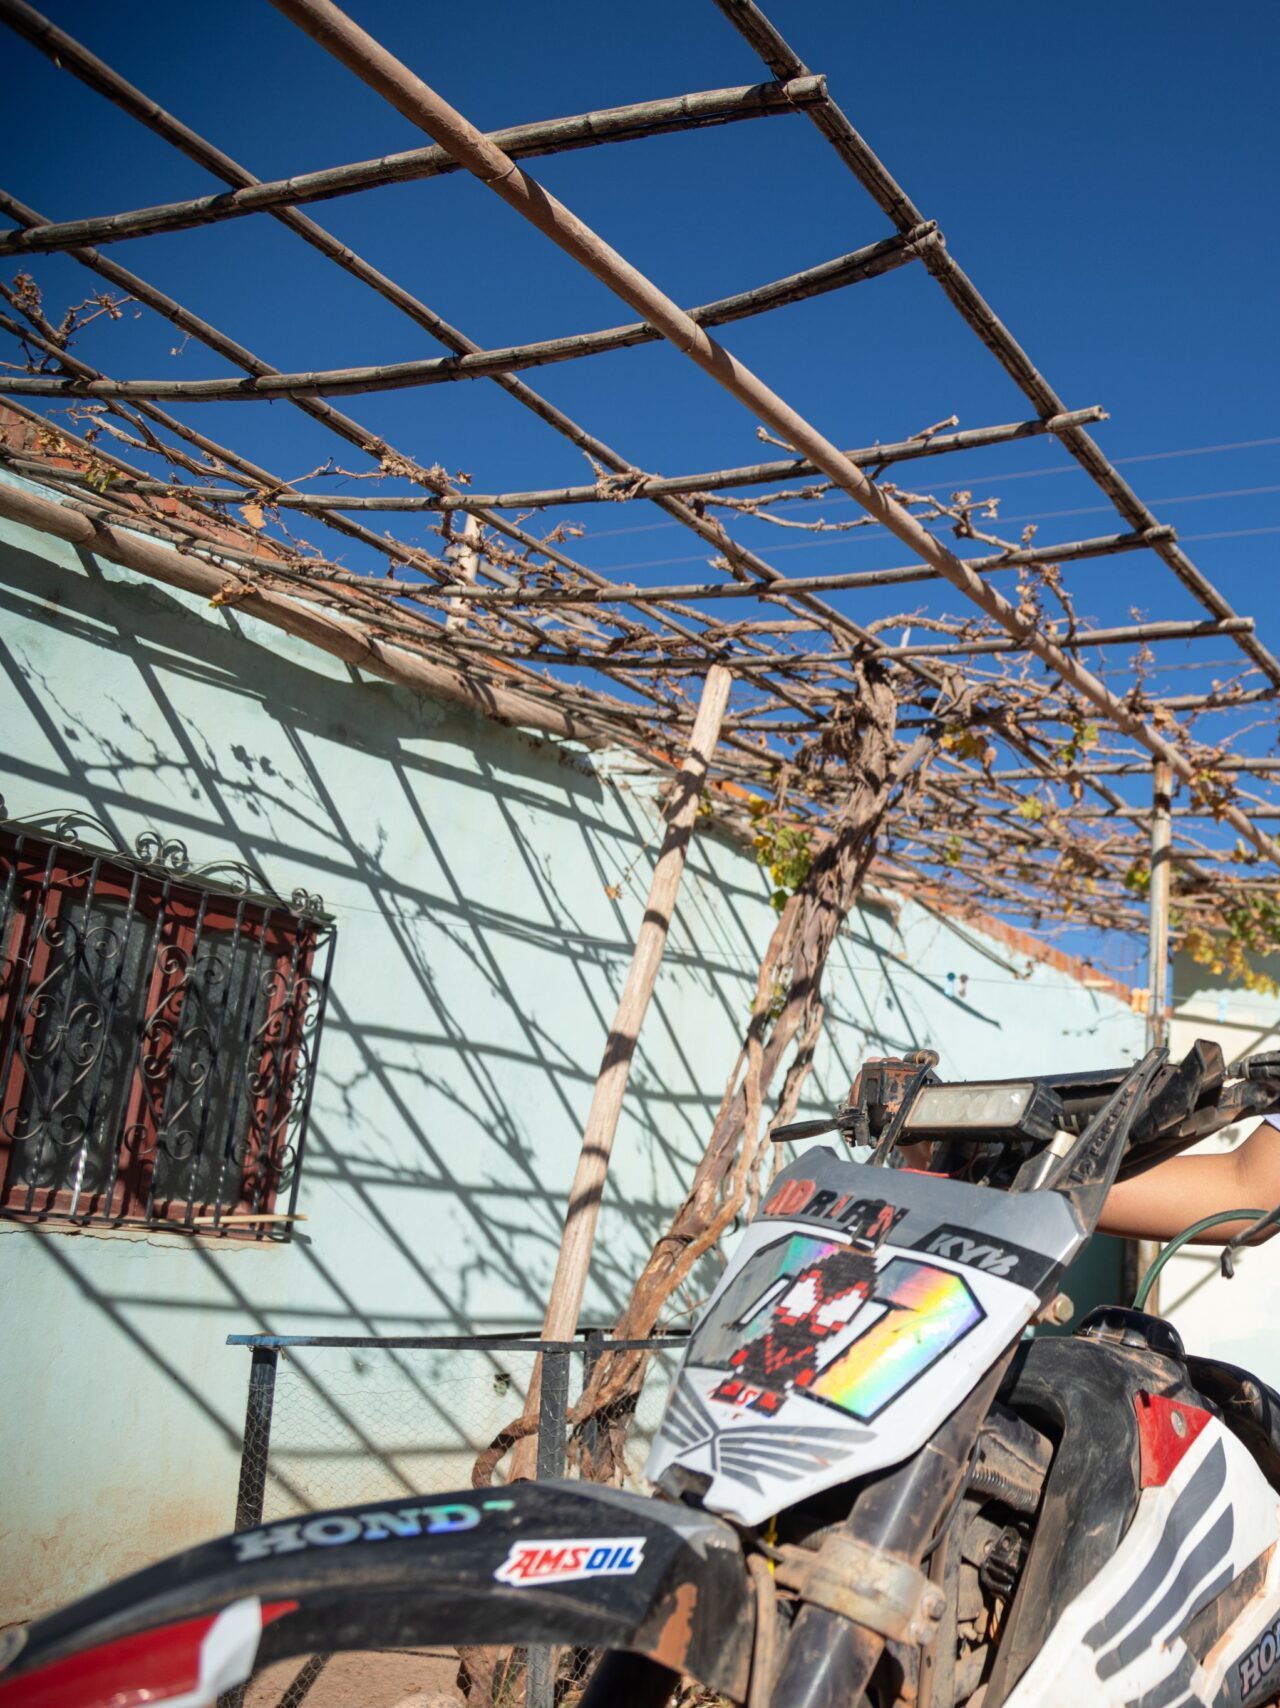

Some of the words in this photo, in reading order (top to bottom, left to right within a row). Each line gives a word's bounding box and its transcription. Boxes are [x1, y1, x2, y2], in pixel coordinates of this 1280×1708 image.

[925, 1232, 1020, 1277] KYB
[233, 1499, 515, 1562] HOND
[506, 1546, 635, 1578] AMSOIL
